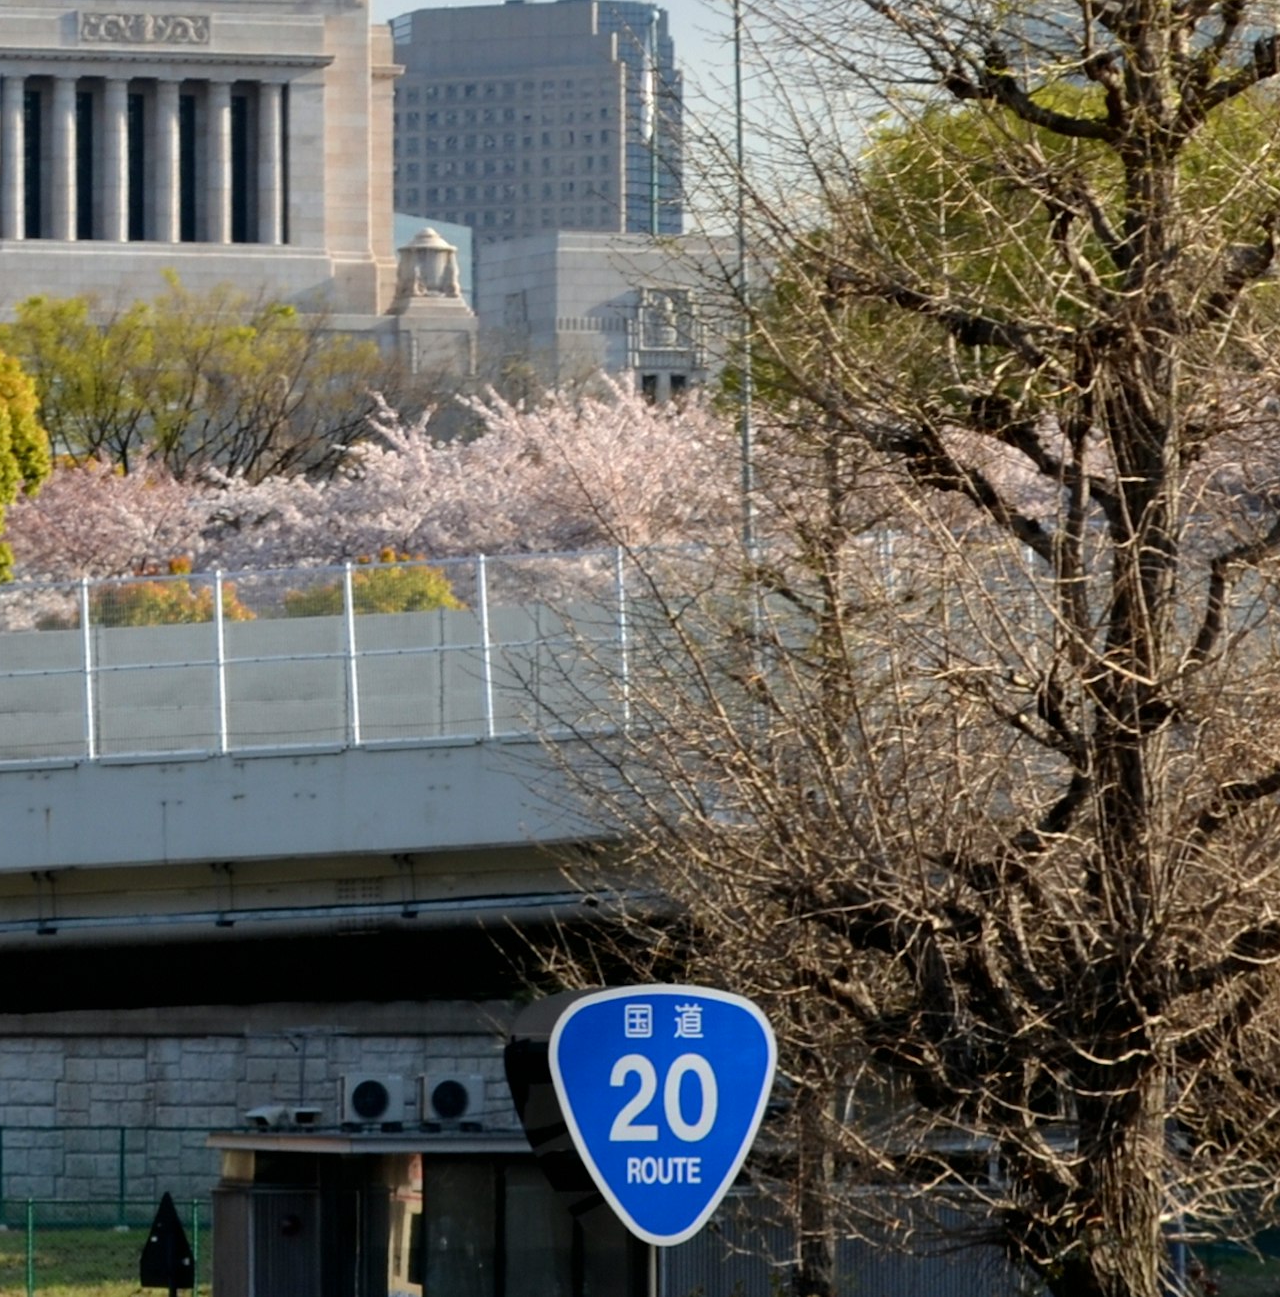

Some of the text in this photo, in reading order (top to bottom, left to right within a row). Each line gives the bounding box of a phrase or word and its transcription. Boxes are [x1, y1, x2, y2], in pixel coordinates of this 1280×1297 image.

[624, 1003, 704, 1039] 国道
[609, 1053, 718, 1142] 20
[627, 1156, 701, 1185] ROUTE
